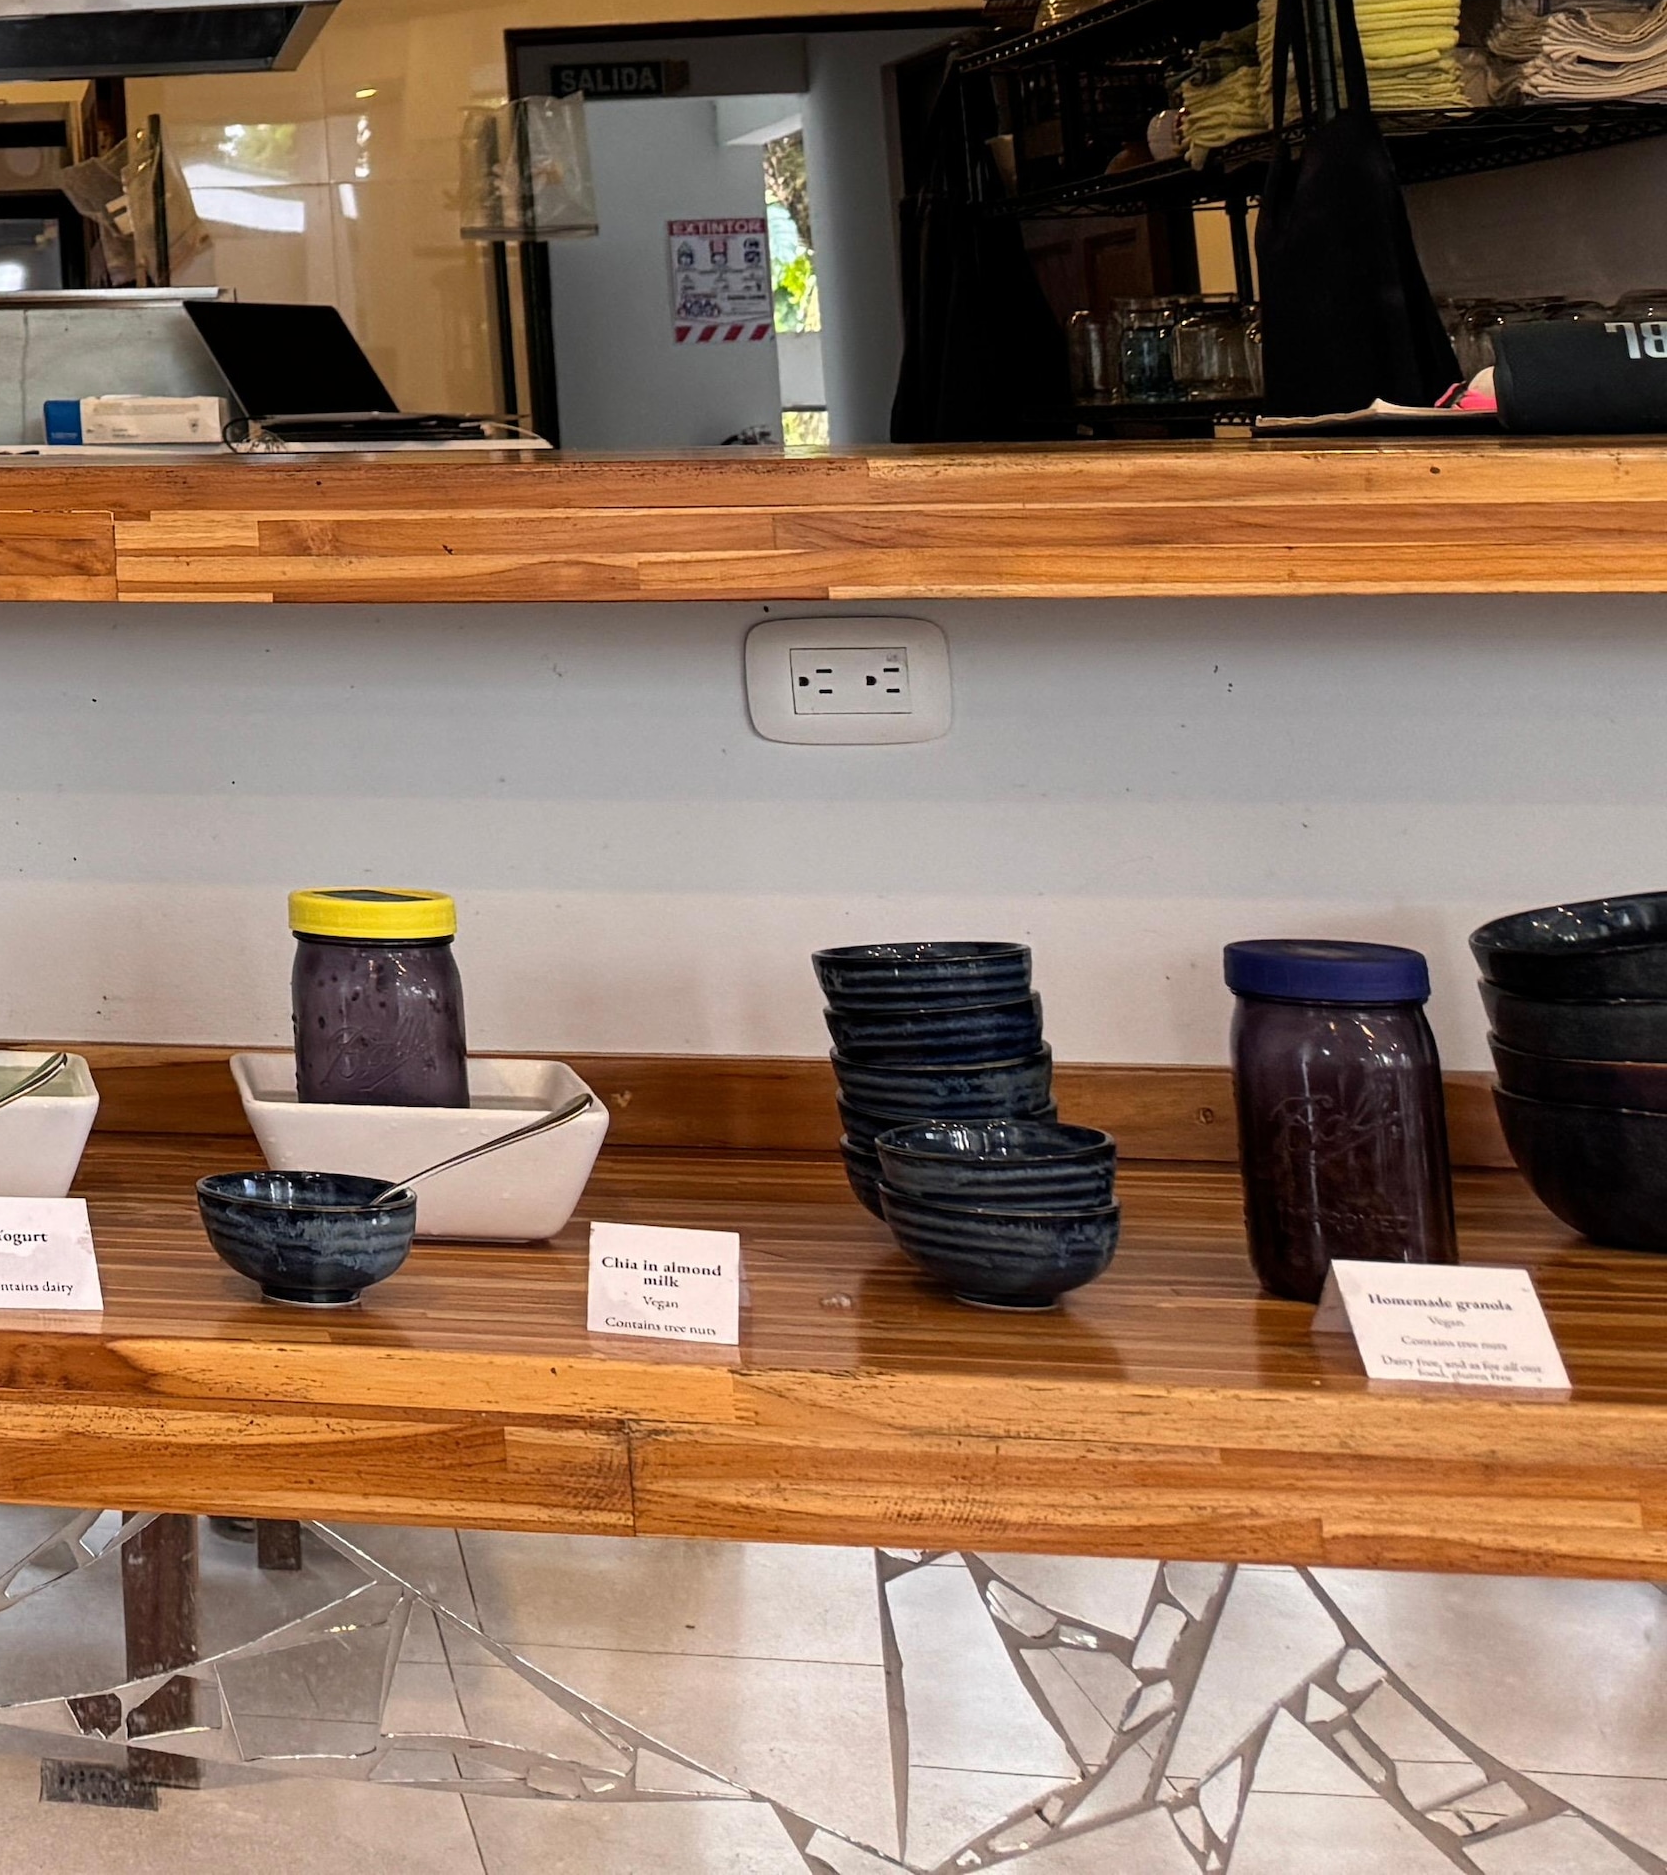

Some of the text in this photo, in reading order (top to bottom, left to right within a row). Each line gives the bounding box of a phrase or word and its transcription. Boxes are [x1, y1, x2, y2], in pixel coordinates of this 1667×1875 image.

[560, 67, 657, 92] SALIDA
[672, 219, 764, 234] EXTINTOR
[1604, 321, 1667, 359] BL
[601, 1256, 721, 1276] Chia in almond
[42, 1281, 73, 1296] dairy
[644, 1275, 679, 1287] milk
[643, 1296, 678, 1311] Vegan
[1368, 1293, 1513, 1312] Homemade granola
[605, 1317, 716, 1336] Contains tree nuts
